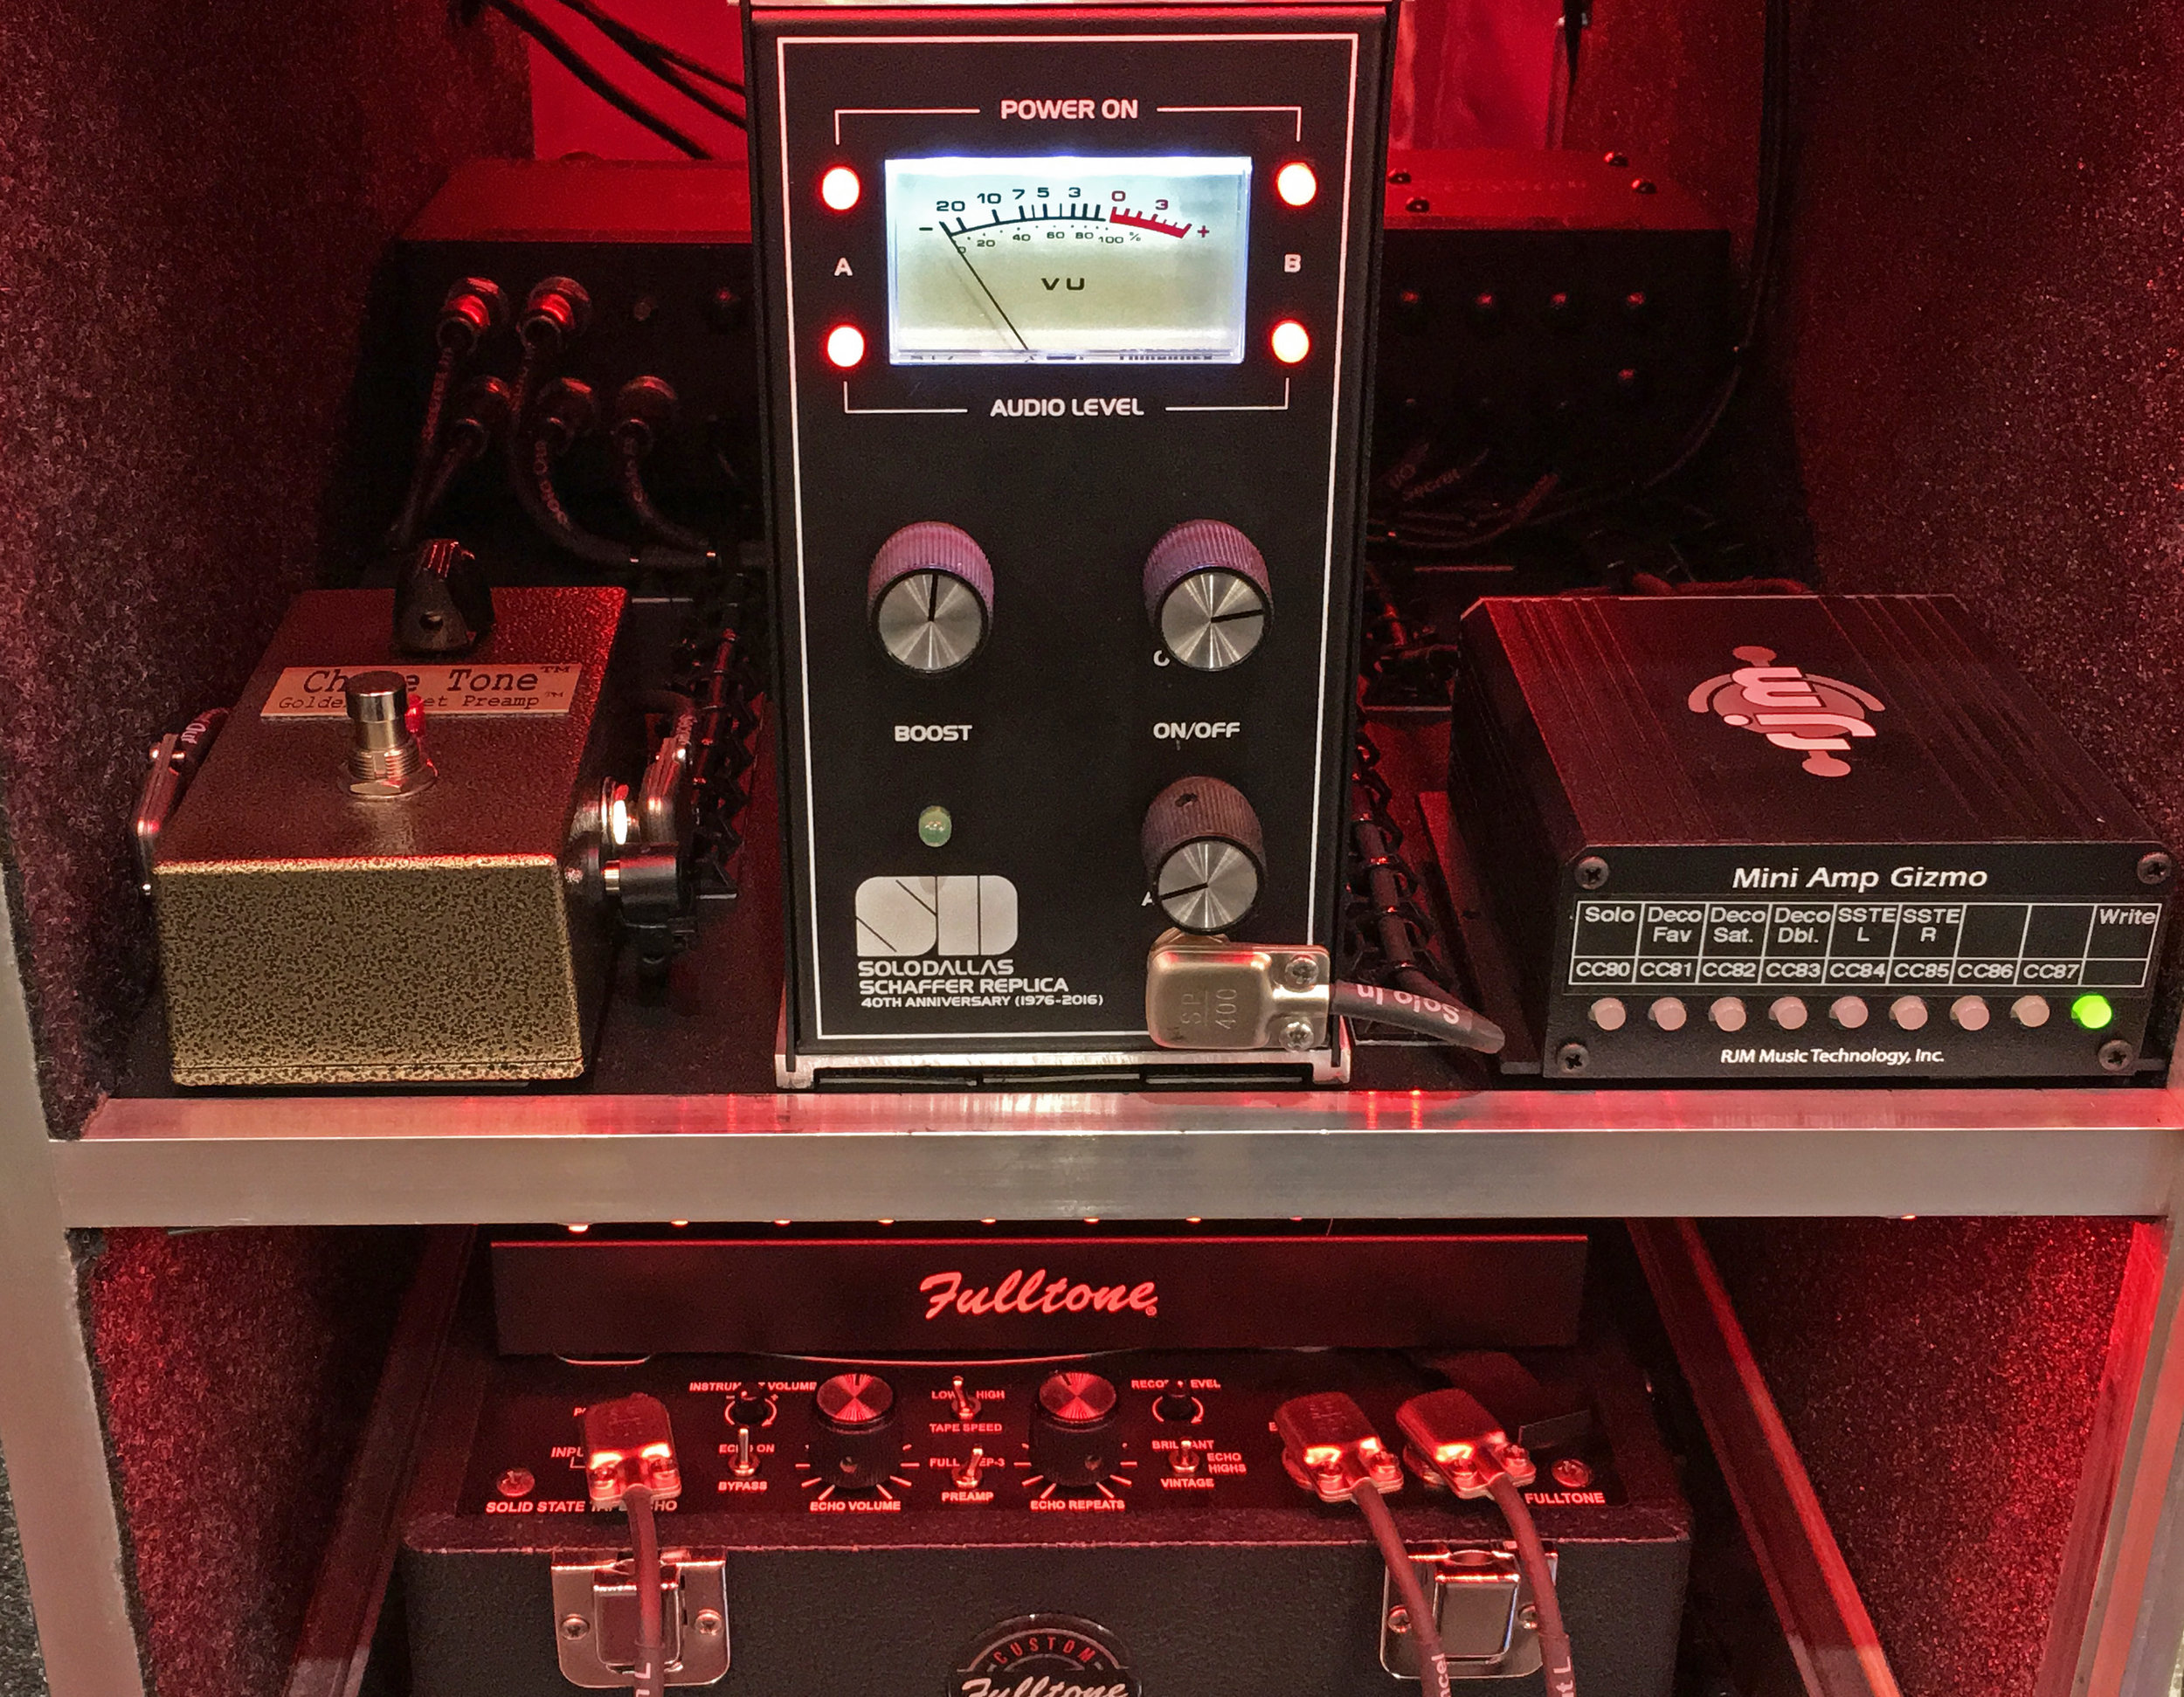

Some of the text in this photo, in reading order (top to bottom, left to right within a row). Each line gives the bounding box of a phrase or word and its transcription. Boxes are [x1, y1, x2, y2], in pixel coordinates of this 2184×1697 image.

[1000, 99, 1139, 120] POWER ON
[936, 187, 1169, 212] 20 10 7 5 3 0 3
[976, 238, 996, 248] 20
[1013, 233, 1031, 242] 40
[1046, 231, 1065, 240] 60
[1075, 231, 1094, 240] 80
[1098, 235, 1124, 245] 100
[833, 257, 854, 277] A
[1283, 254, 1302, 273] B
[989, 397, 1145, 417] AUDIO LEVEL
[303, 668, 420, 693] Che
[446, 668, 539, 692] Tone
[278, 695, 348, 709] Golde
[462, 694, 540, 710] Preamp
[894, 724, 973, 742] BOOST
[1153, 721, 1241, 741] ON/OFF
[1731, 866, 1988, 893] Mini Amp Gizmo
[1584, 906, 1636, 923] Solo
[1647, 907, 1704, 923] Deco
[1710, 907, 1766, 924] Deco
[1773, 907, 1831, 924] Deco
[1837, 907, 1897, 923] SSTE
[1903, 907, 1961, 924] SSTE
[2098, 908, 2157, 926] Write
[1653, 927, 1692, 943] Fav
[1713, 927, 1754, 943] Sat.
[1777, 927, 1819, 943] Dbl.
[1856, 926, 1870, 942] L
[1920, 926, 1937, 942] R
[857, 958, 1014, 977] SOLODALLAS
[1575, 962, 1631, 977] CC80
[1639, 962, 1692, 977] CC81
[1702, 962, 1757, 978] CC82
[1765, 962, 1821, 978] CC83
[1828, 962, 1886, 978] CC84
[1894, 962, 1951, 979] CC85
[1957, 962, 2014, 979] CC86
[2022, 963, 2081, 979] CC87
[859, 977, 1069, 996] SCHAFFER REPLICA
[860, 994, 1104, 1008] 40TH ANNIVERSARY (1976-2016)
[1356, 983, 1461, 1025] Solo In
[1720, 1047, 1945, 1066] RJM Music Technology, Inc.
[767, 1381, 818, 1391] VOLUME
[976, 1390, 1006, 1400] HIGH
[929, 1423, 1003, 1433] TAPE SPEED
[756, 1443, 776, 1453] ON
[930, 1457, 961, 1468] FULL
[1206, 1452, 1242, 1463] ECHO
[1207, 1463, 1247, 1474] HIGHS
[718, 1480, 768, 1493] BYPASS
[1160, 1478, 1215, 1488] VINTAGE
[941, 1492, 994, 1502] PREAMP
[1524, 1492, 1607, 1504] FULLTONE
[485, 1500, 534, 1514] SOLID
[536, 1500, 586, 1513] STATE
[809, 1500, 902, 1512] ECHO VOLUME
[1030, 1500, 1126, 1511] ECHO REPEATS
[992, 1636, 1096, 1665] CUSTOM
